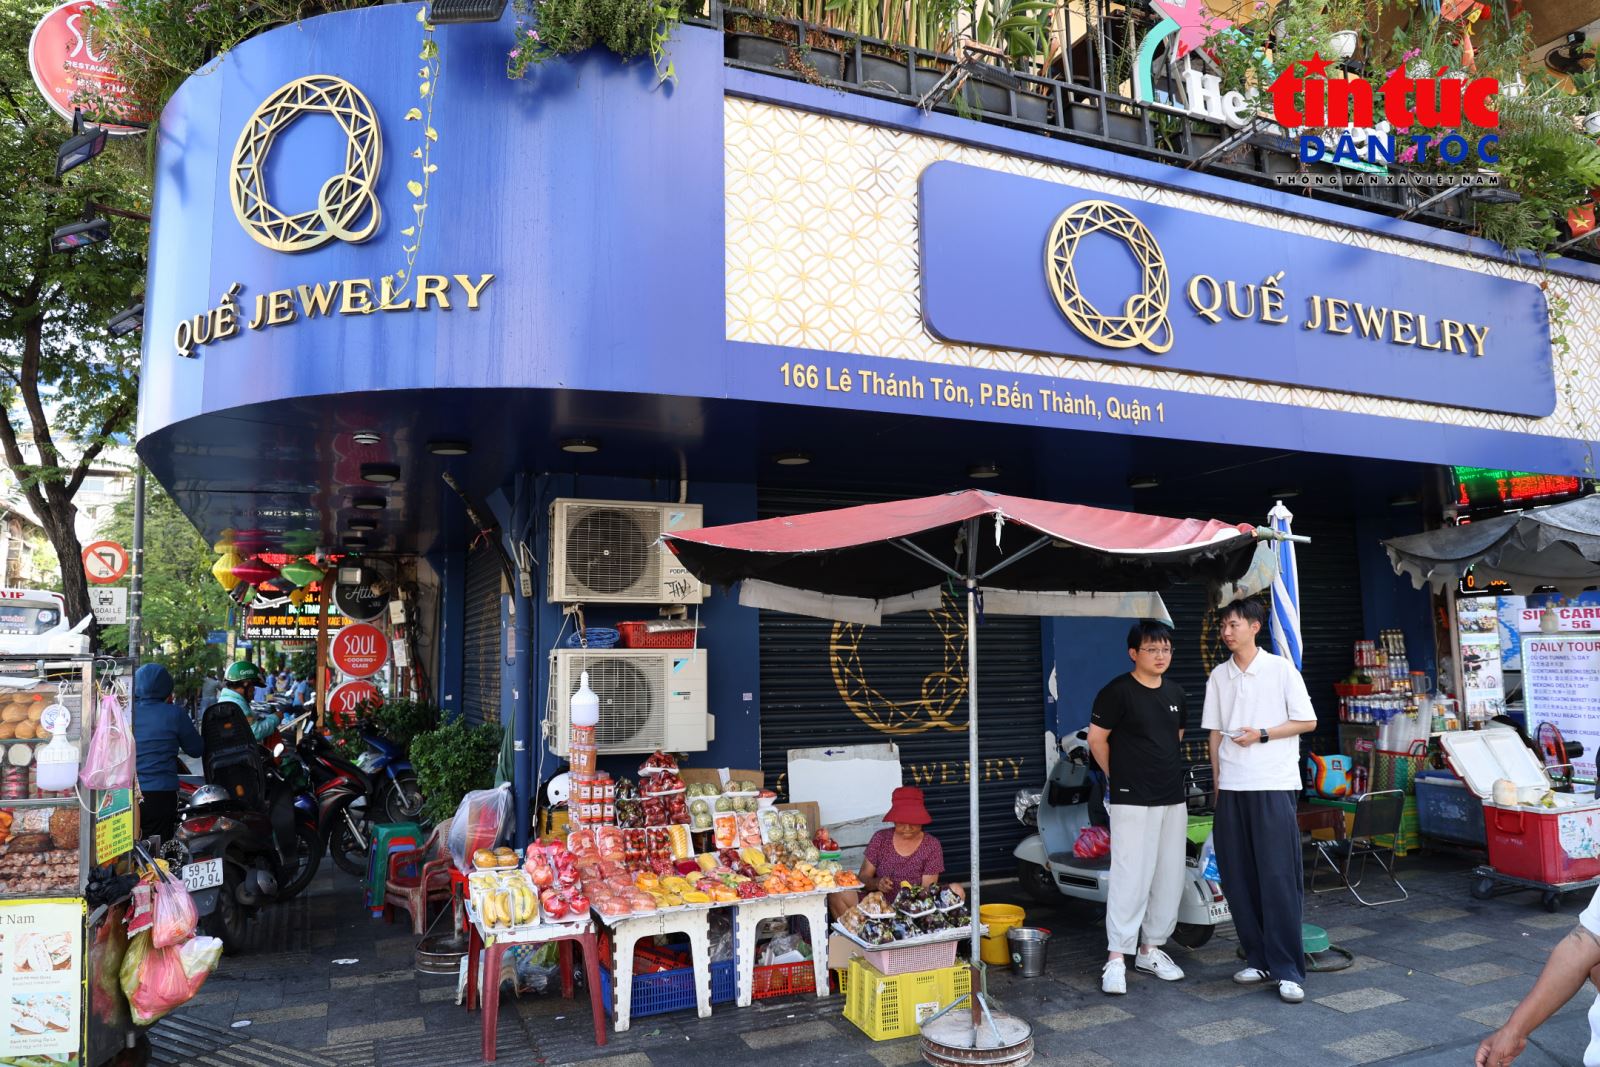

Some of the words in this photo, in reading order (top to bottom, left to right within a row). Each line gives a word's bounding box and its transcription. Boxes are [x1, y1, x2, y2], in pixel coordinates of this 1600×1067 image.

[174, 282, 241, 358] QUẾ
[248, 274, 496, 330] JEWELRY
[1187, 271, 1288, 323] QUẾ
[1305, 295, 1490, 356] JEWELRY
[780, 362, 819, 389] 166
[826, 367, 852, 392] Lê
[858, 370, 924, 399] Thánh
[930, 377, 974, 408] Tôn,
[980, 381, 1033, 410] P.Bến
[1039, 389, 1102, 421] Thành,
[1106, 396, 1151, 425] Quận
[1156, 402, 1165, 422] 1
[1572, 620, 1591, 629] 5G
[344, 635, 377, 655] SOUL
[1530, 642, 1563, 652] DAILY
[189, 862, 217, 877] 59-T2
[7, 914, 35, 925] Nam
